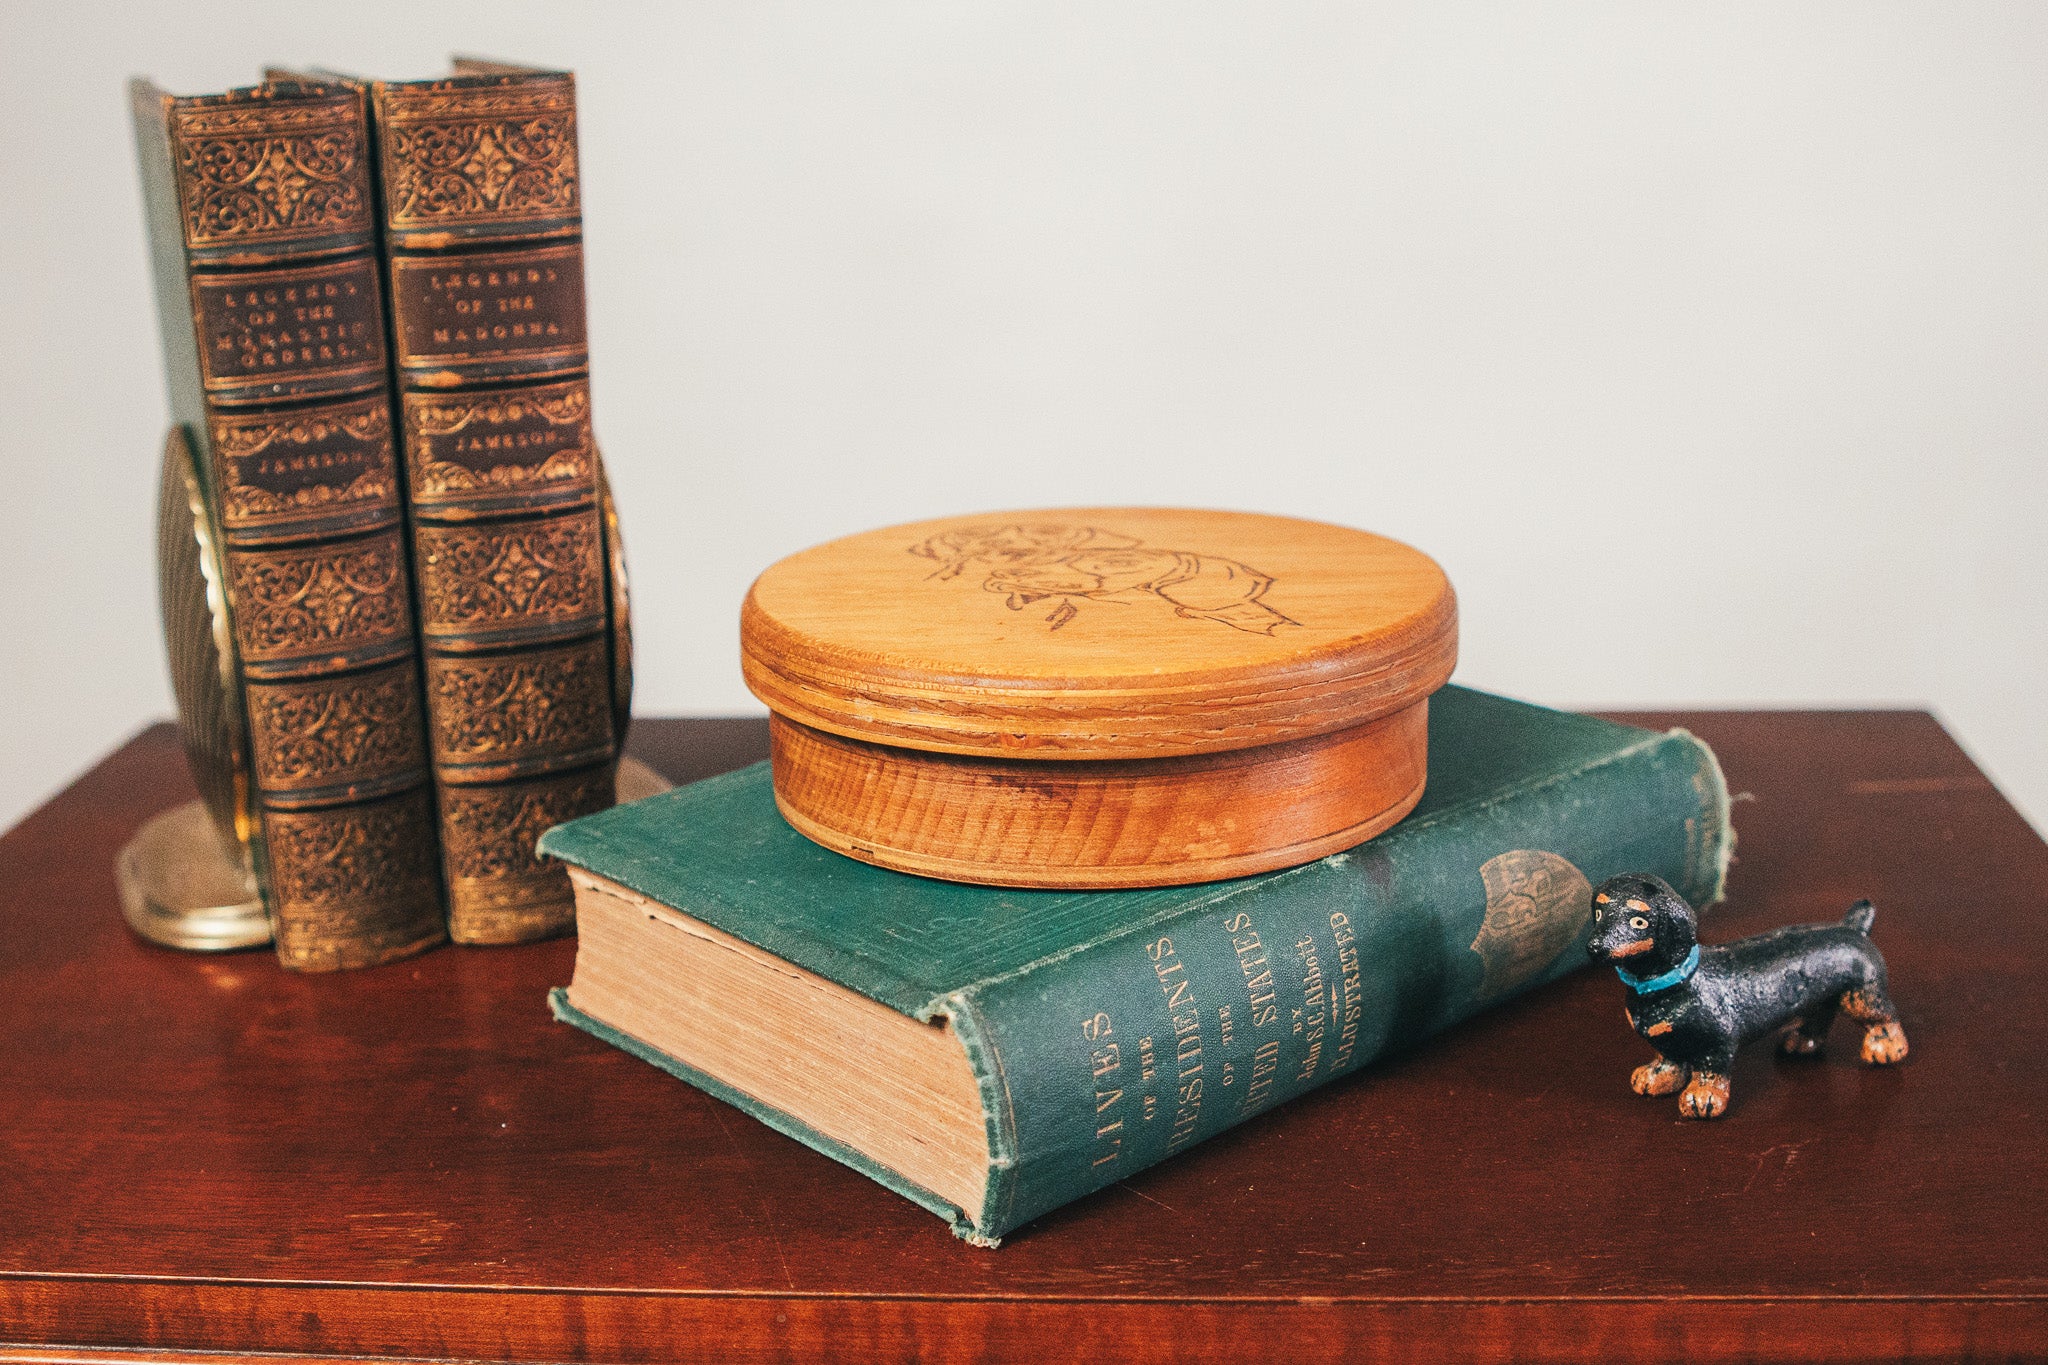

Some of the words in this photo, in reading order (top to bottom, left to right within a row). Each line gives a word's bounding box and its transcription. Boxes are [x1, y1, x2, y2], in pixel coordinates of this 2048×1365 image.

[456, 299, 482, 315] OF
[433, 322, 560, 344] MADONNA
[1224, 912, 1278, 1028] STATES
[1218, 1004, 1234, 1046] THE
[1291, 1008, 1303, 1035] BY
[1138, 1036, 1156, 1082] THE
[1146, 936, 1204, 1155] RESIDENTS
[1081, 1011, 1124, 1168] LIVES
[1222, 1062, 1235, 1087] OF
[1240, 1040, 1281, 1117] NITED
[1143, 1094, 1157, 1121] OF
